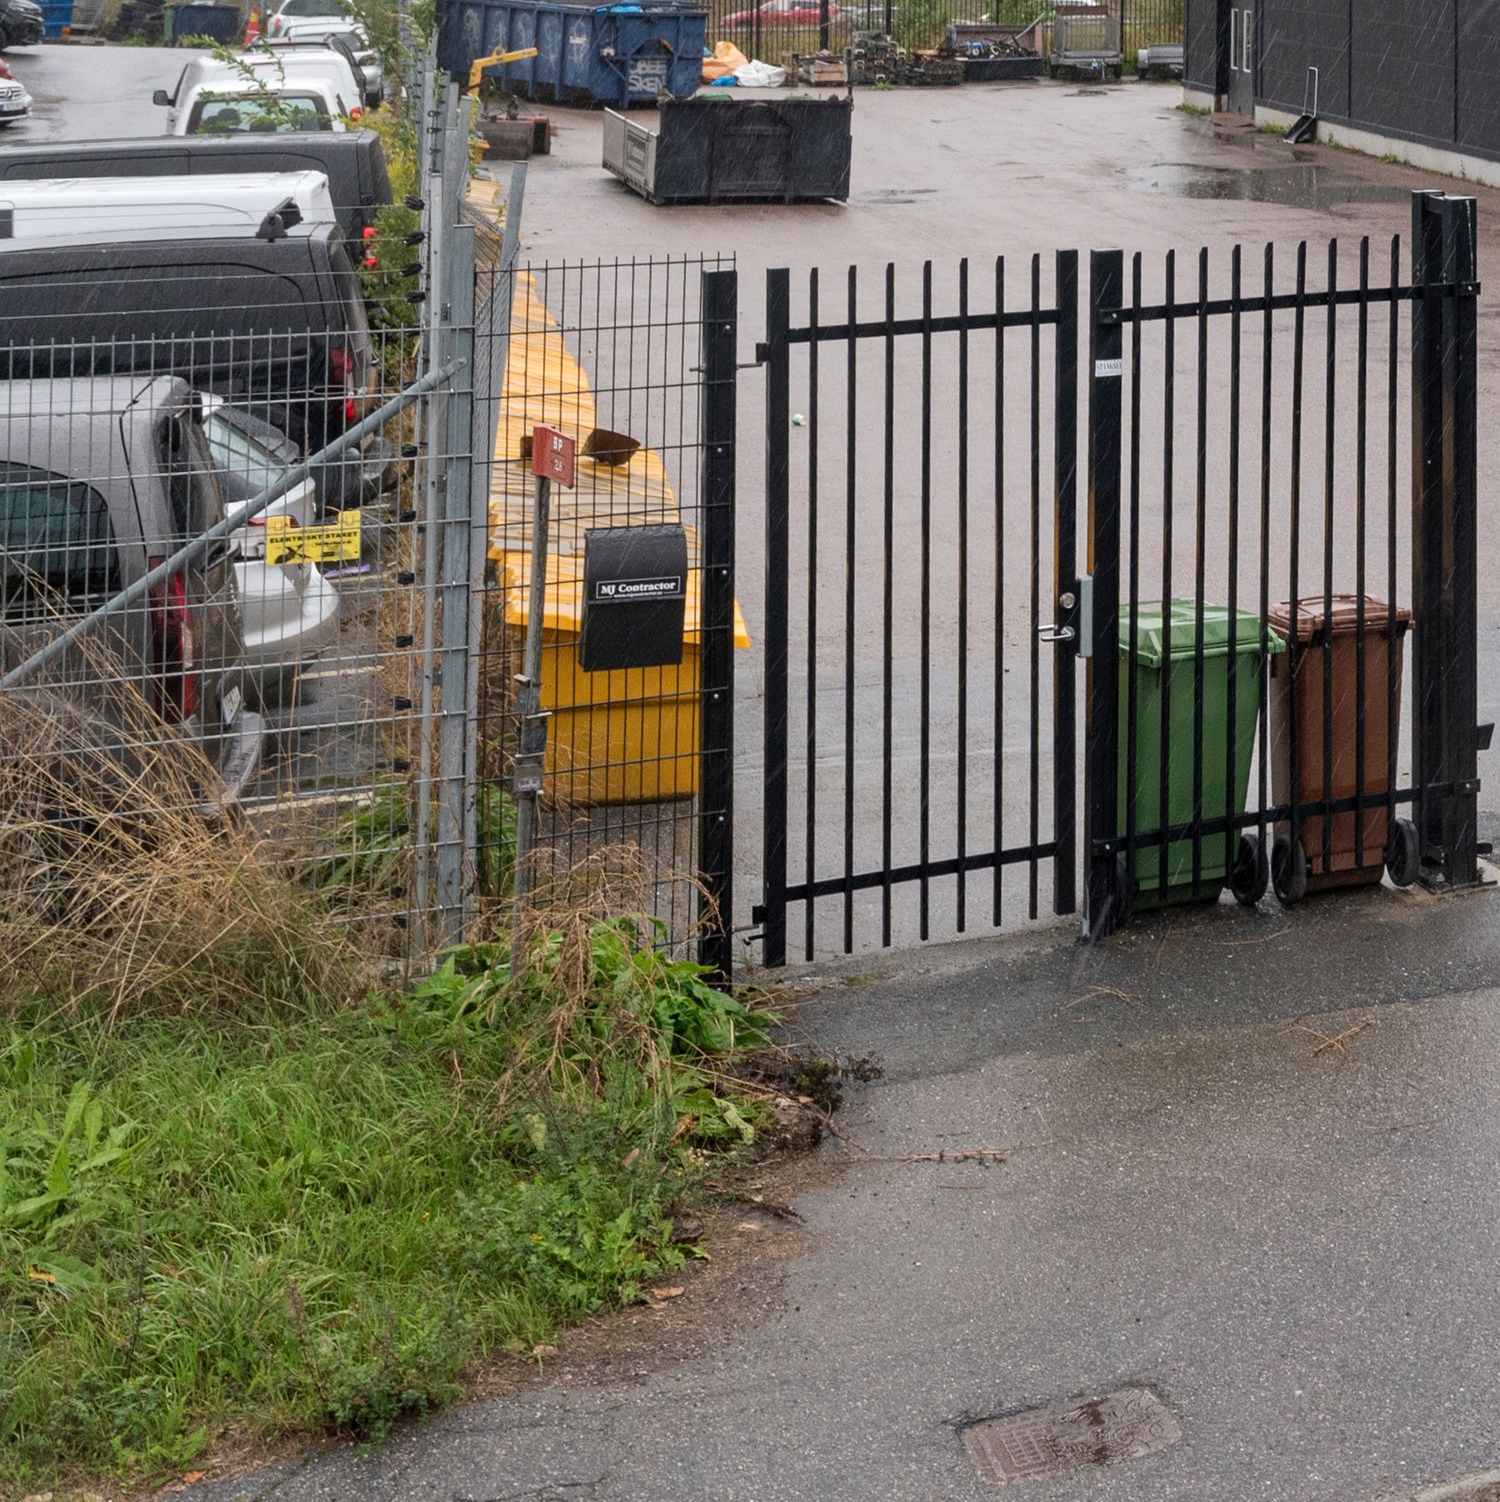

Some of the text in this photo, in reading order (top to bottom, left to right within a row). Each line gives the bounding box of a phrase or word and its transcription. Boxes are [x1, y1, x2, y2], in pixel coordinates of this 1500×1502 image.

[270, 534, 322, 544] ELEKTRSKT
[601, 581, 676, 595] MJ Contractor
